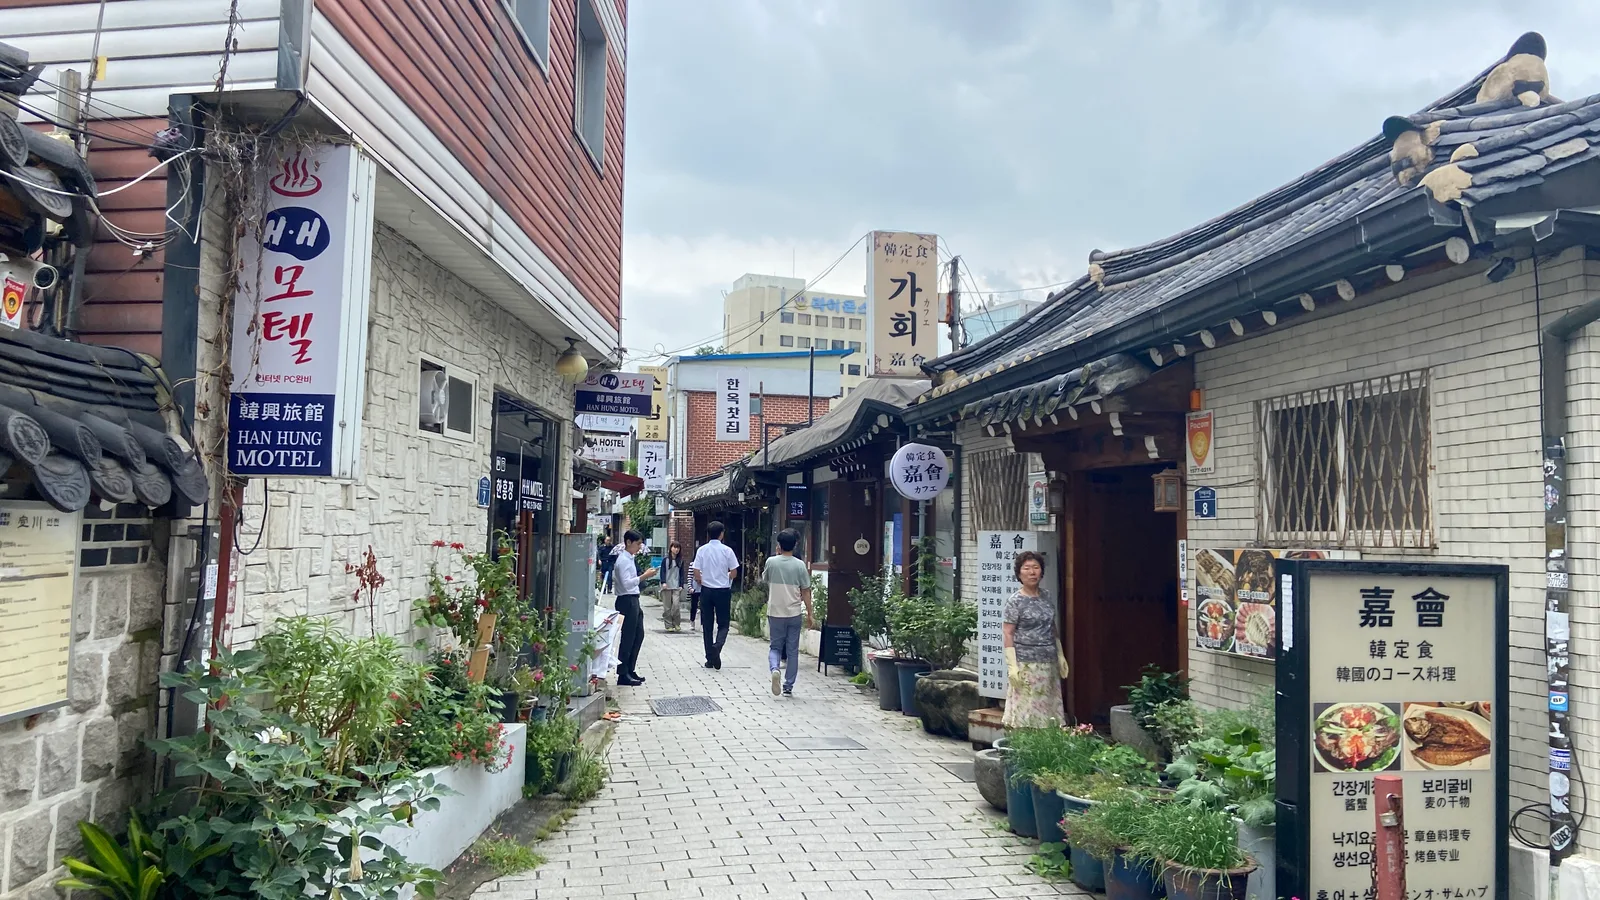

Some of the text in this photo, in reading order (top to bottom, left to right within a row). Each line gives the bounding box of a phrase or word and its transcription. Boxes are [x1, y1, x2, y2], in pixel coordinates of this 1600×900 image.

[884, 242, 928, 259] 韓定食
[262, 264, 314, 365] 모텔
[888, 271, 923, 347] 가회
[889, 352, 925, 367] 嘉會
[283, 375, 312, 384] PC완비
[620, 379, 645, 393] 모텔
[596, 394, 632, 405] 韓興旅館
[726, 378, 740, 434] 한옥찻집
[239, 401, 325, 422] 韓興旅館
[586, 403, 640, 414] HAN HUNG MOTEL
[236, 430, 323, 446] HAN HUNG
[599, 438, 625, 448] HOSTEL
[235, 449, 322, 468] MOTEL
[905, 451, 936, 462] 韓定食
[644, 451, 657, 480] 귀천
[901, 463, 944, 484] 嘉會
[496, 478, 514, 501] 한흥장
[914, 485, 938, 494] カフェ
[1202, 502, 1208, 515] 8
[990, 534, 1025, 550] 嘉會
[981, 562, 1002, 571] 간장게장
[981, 574, 1002, 583] 보리굴비
[981, 609, 1003, 618] 갈치조림
[1358, 585, 1451, 629] 嘉會
[981, 621, 1003, 629] 갈치구이
[981, 633, 1003, 642] 조기구이
[1369, 638, 1434, 660] 韓定食
[1335, 665, 1457, 683] 韓國のコース料理
[1332, 780, 1375, 796] 간장게
[1421, 778, 1472, 794] 보리굴비
[1424, 795, 1471, 809] 麦の干物
[1332, 831, 1376, 847] 낙지요
[1332, 851, 1376, 868] 생선요
